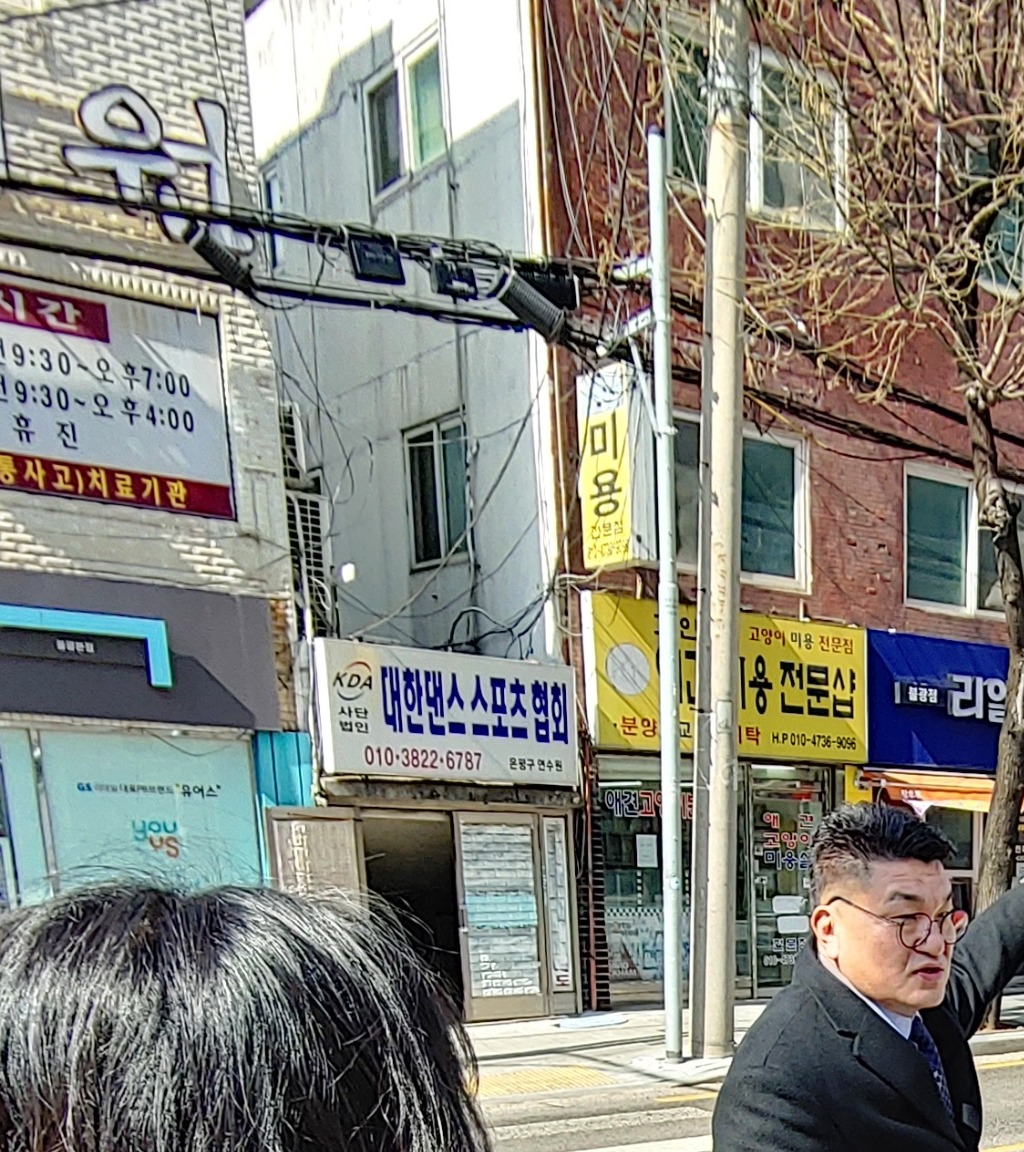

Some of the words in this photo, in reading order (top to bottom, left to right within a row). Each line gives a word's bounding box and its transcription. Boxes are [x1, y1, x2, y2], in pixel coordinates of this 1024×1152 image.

[589, 411, 622, 517] 미용
[749, 626, 786, 647] 고양이
[790, 631, 814, 650] 미용
[818, 635, 854, 655] 전문점
[333, 671, 373, 691] KDA
[780, 660, 857, 720] 전문샵
[908, 685, 938, 704] 불광점
[338, 705, 369, 720] 사단
[338, 720, 370, 734] 법인
[620, 716, 658, 738] 분양
[790, 732, 857, 751] 010-4736-9096
[537, 759, 563, 772] 연수원
[132, 819, 178, 842] you
